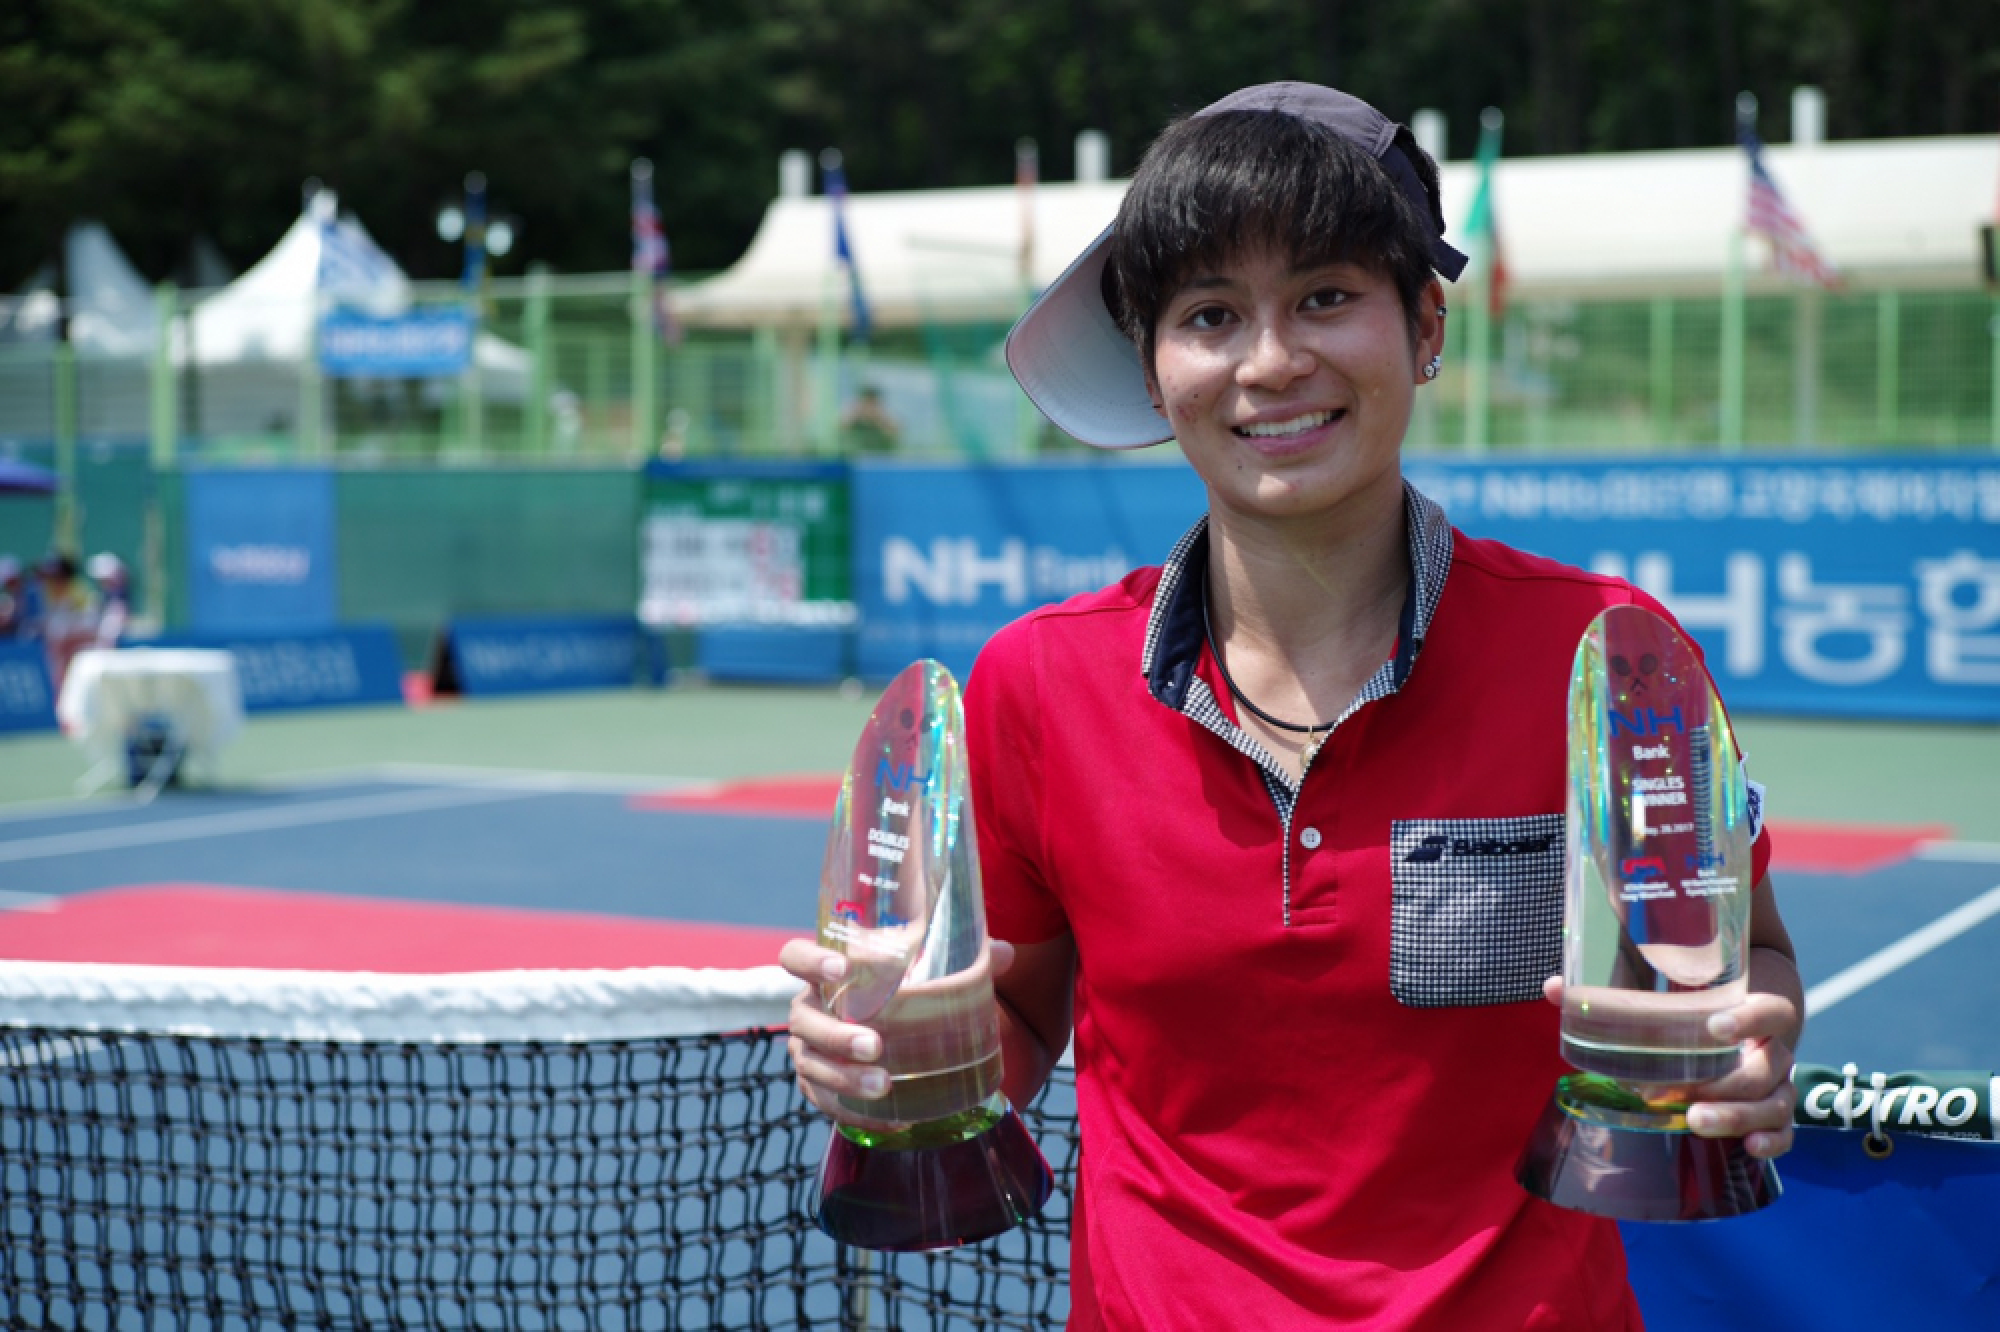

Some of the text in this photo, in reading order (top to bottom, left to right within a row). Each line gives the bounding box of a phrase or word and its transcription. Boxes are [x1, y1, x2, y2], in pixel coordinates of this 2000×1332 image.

[881, 537, 1027, 607] NH
[1592, 549, 2000, 684] H농협
[1607, 706, 1685, 738] NH
[1632, 743, 1671, 760] Bank
[875, 758, 933, 796] NH
[1642, 791, 1688, 806] INNER
